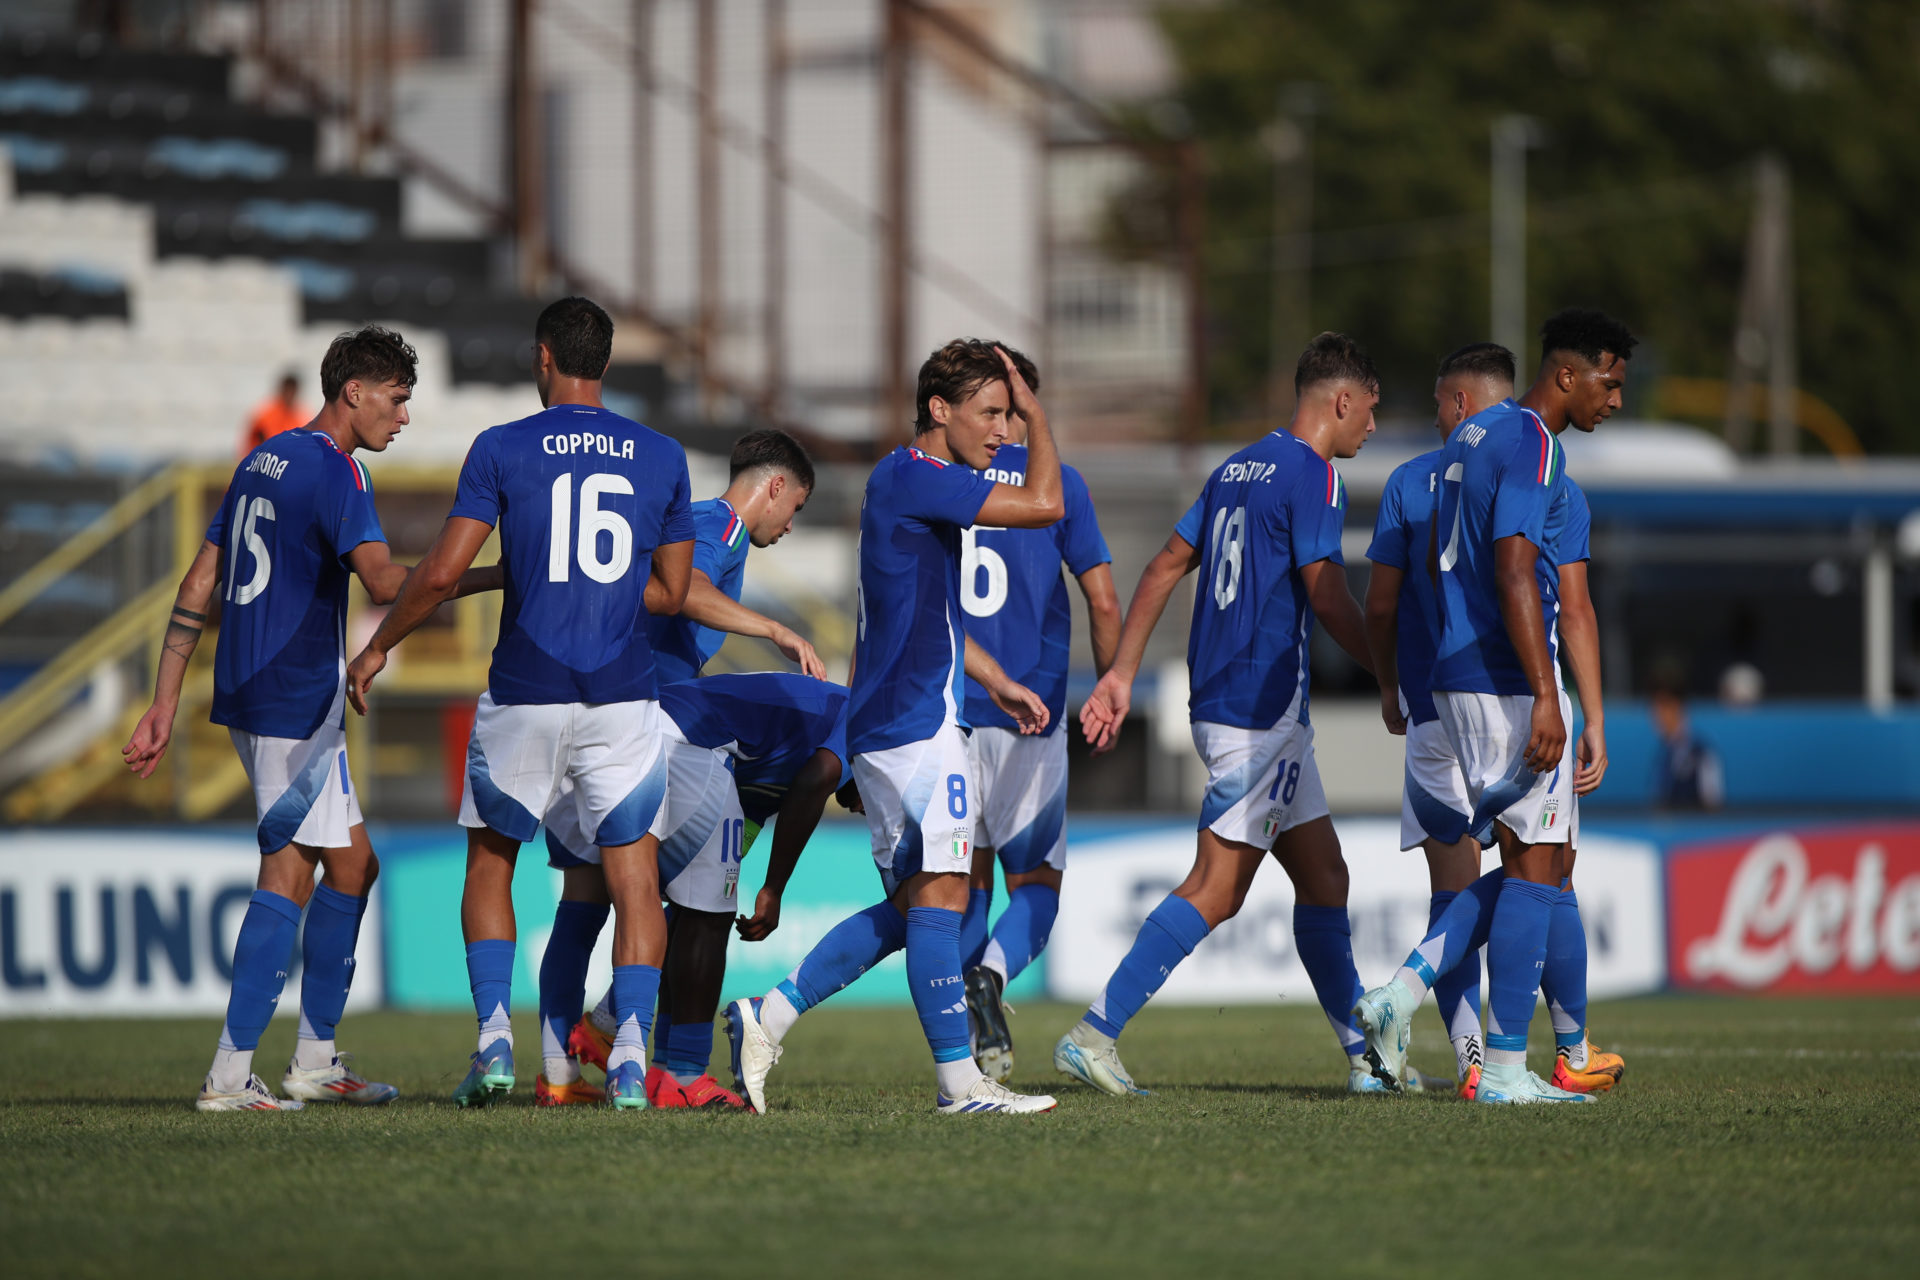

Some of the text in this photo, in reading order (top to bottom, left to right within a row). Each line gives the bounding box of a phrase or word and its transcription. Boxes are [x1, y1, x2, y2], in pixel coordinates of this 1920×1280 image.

[542, 432, 635, 460] COPPOLA
[226, 494, 276, 605] 15
[548, 472, 635, 584] 16
[960, 524, 1009, 618] 6
[1206, 506, 1246, 610] 18
[947, 773, 968, 820] 8
[1268, 758, 1300, 805] 18
[721, 818, 744, 863] 10
[1684, 832, 1920, 988] Lete
